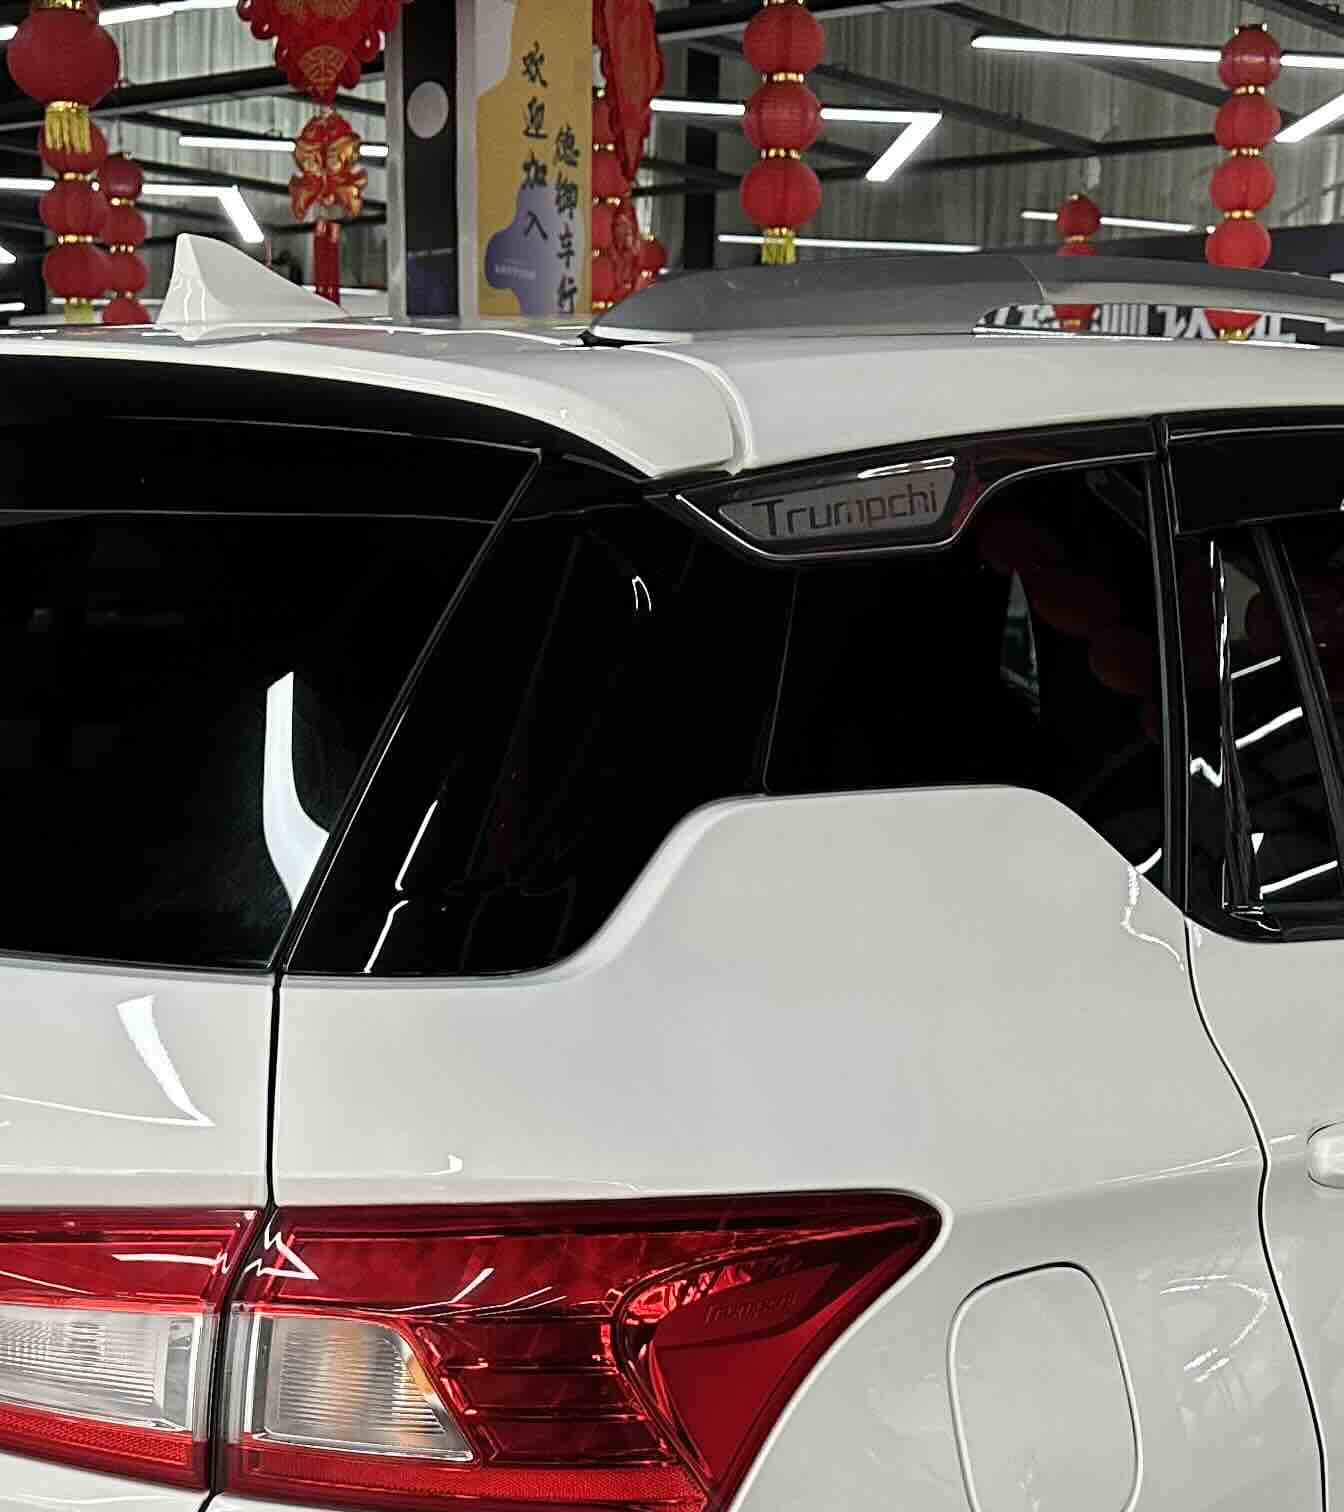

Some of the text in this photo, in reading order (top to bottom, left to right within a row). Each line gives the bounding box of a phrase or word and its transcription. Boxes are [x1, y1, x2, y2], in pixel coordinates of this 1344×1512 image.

[522, 40, 549, 241] 欢迎加入
[751, 483, 938, 537] Trumpchi
